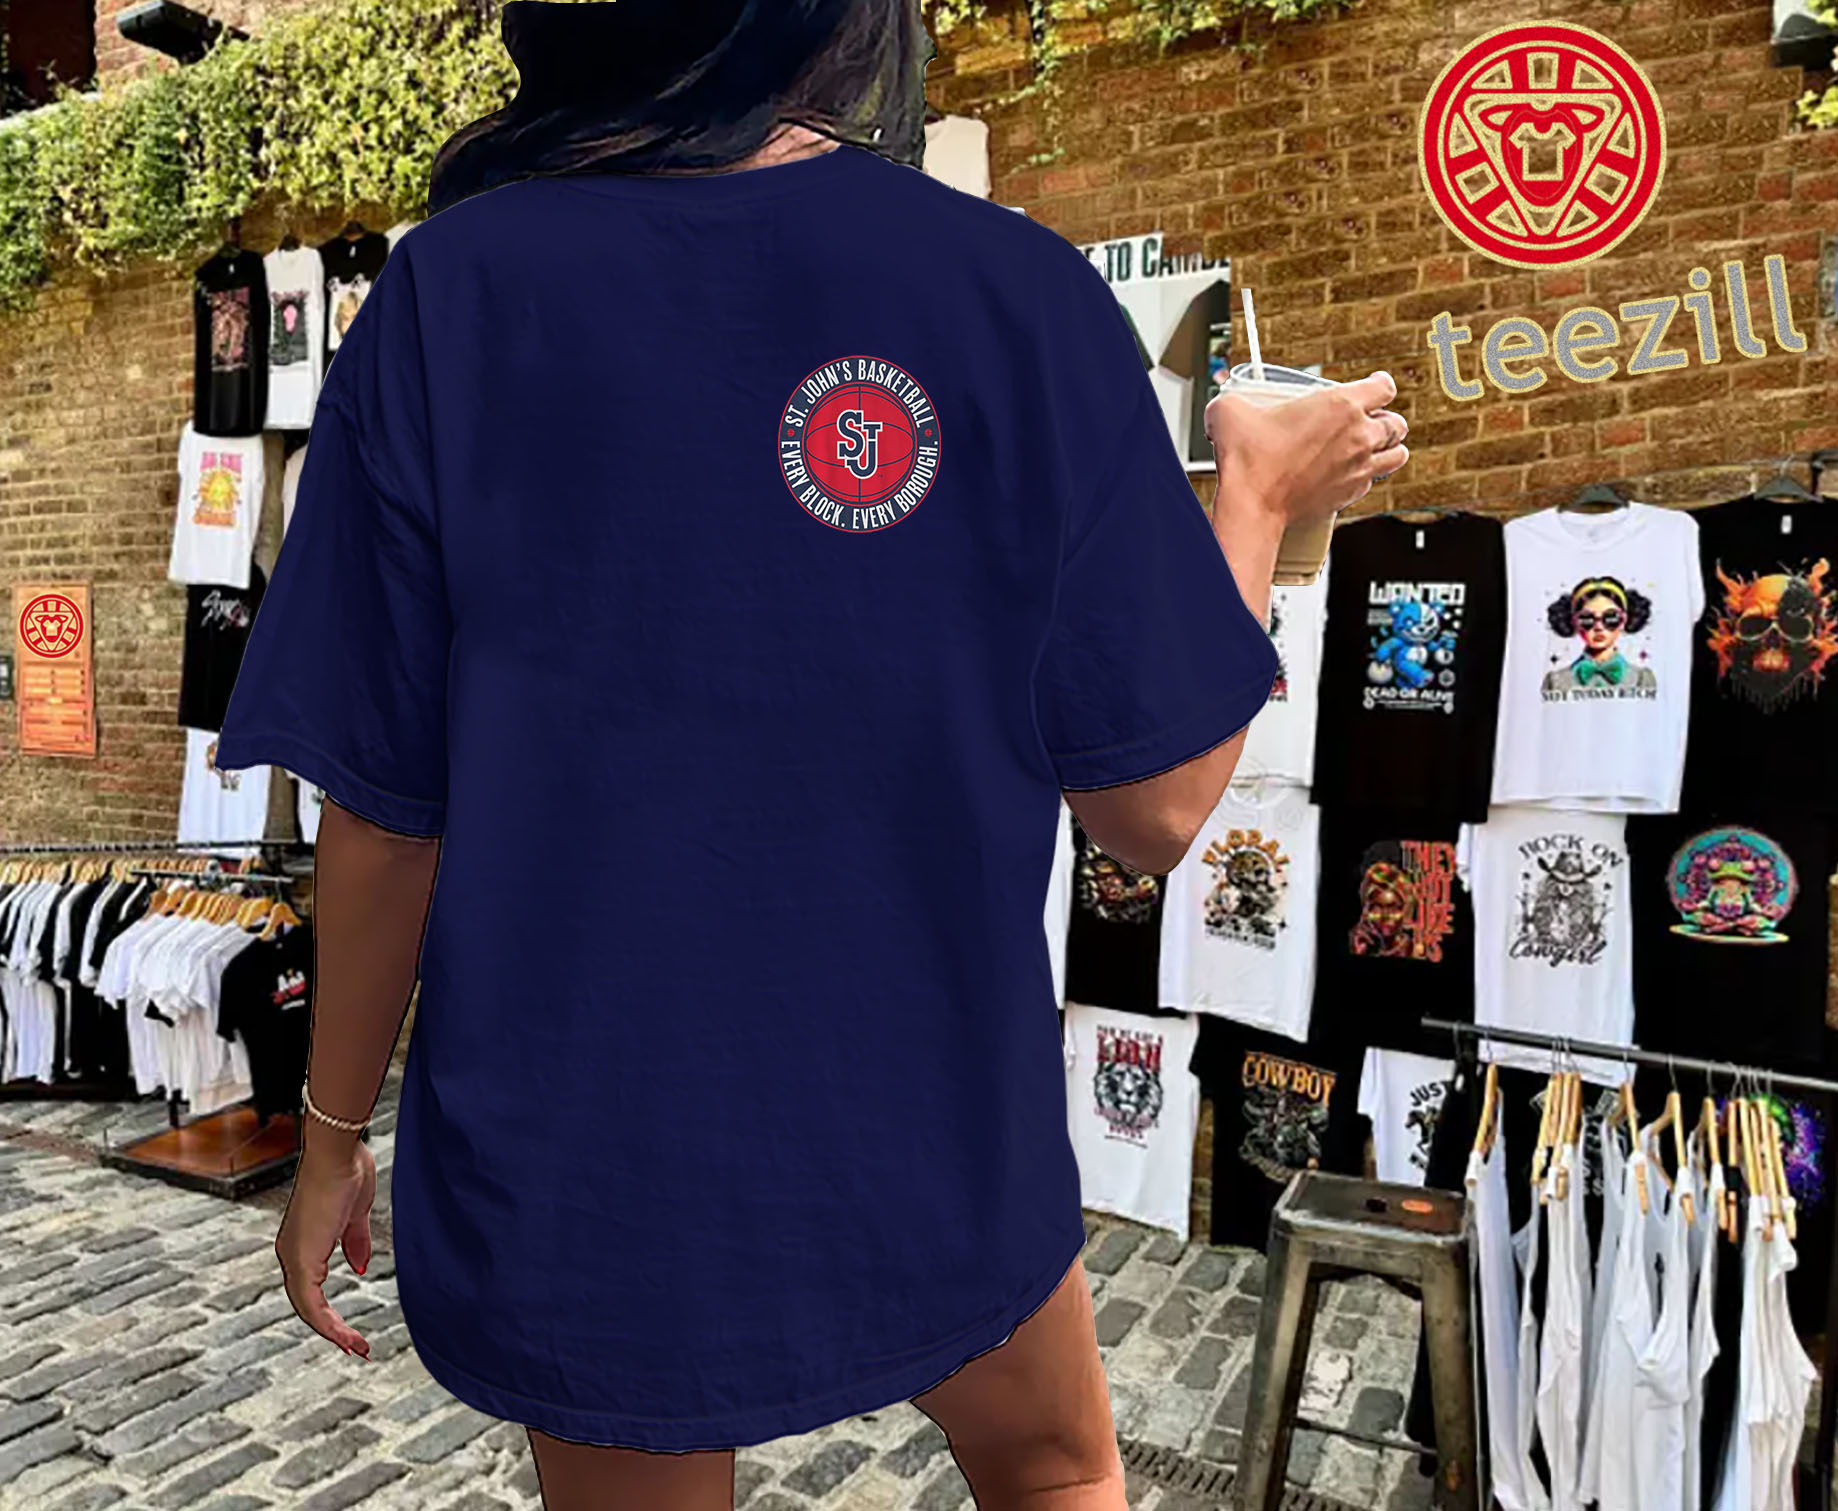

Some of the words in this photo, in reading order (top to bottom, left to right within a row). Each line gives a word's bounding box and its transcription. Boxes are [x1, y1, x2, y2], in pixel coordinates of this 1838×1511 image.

[1105, 241, 1132, 283] TO
[784, 404, 810, 428] ST.
[800, 360, 852, 405] JOHN'S
[858, 359, 935, 428] BASKETBALL
[781, 441, 810, 489] EVERY
[799, 485, 846, 528] BLOCK.
[852, 500, 897, 530] EVERY
[893, 440, 939, 514] BOROUGH.
[1369, 581, 1466, 606] WANTED
[1591, 843, 1624, 868] ON
[1242, 1054, 1337, 1108] COWBOY
